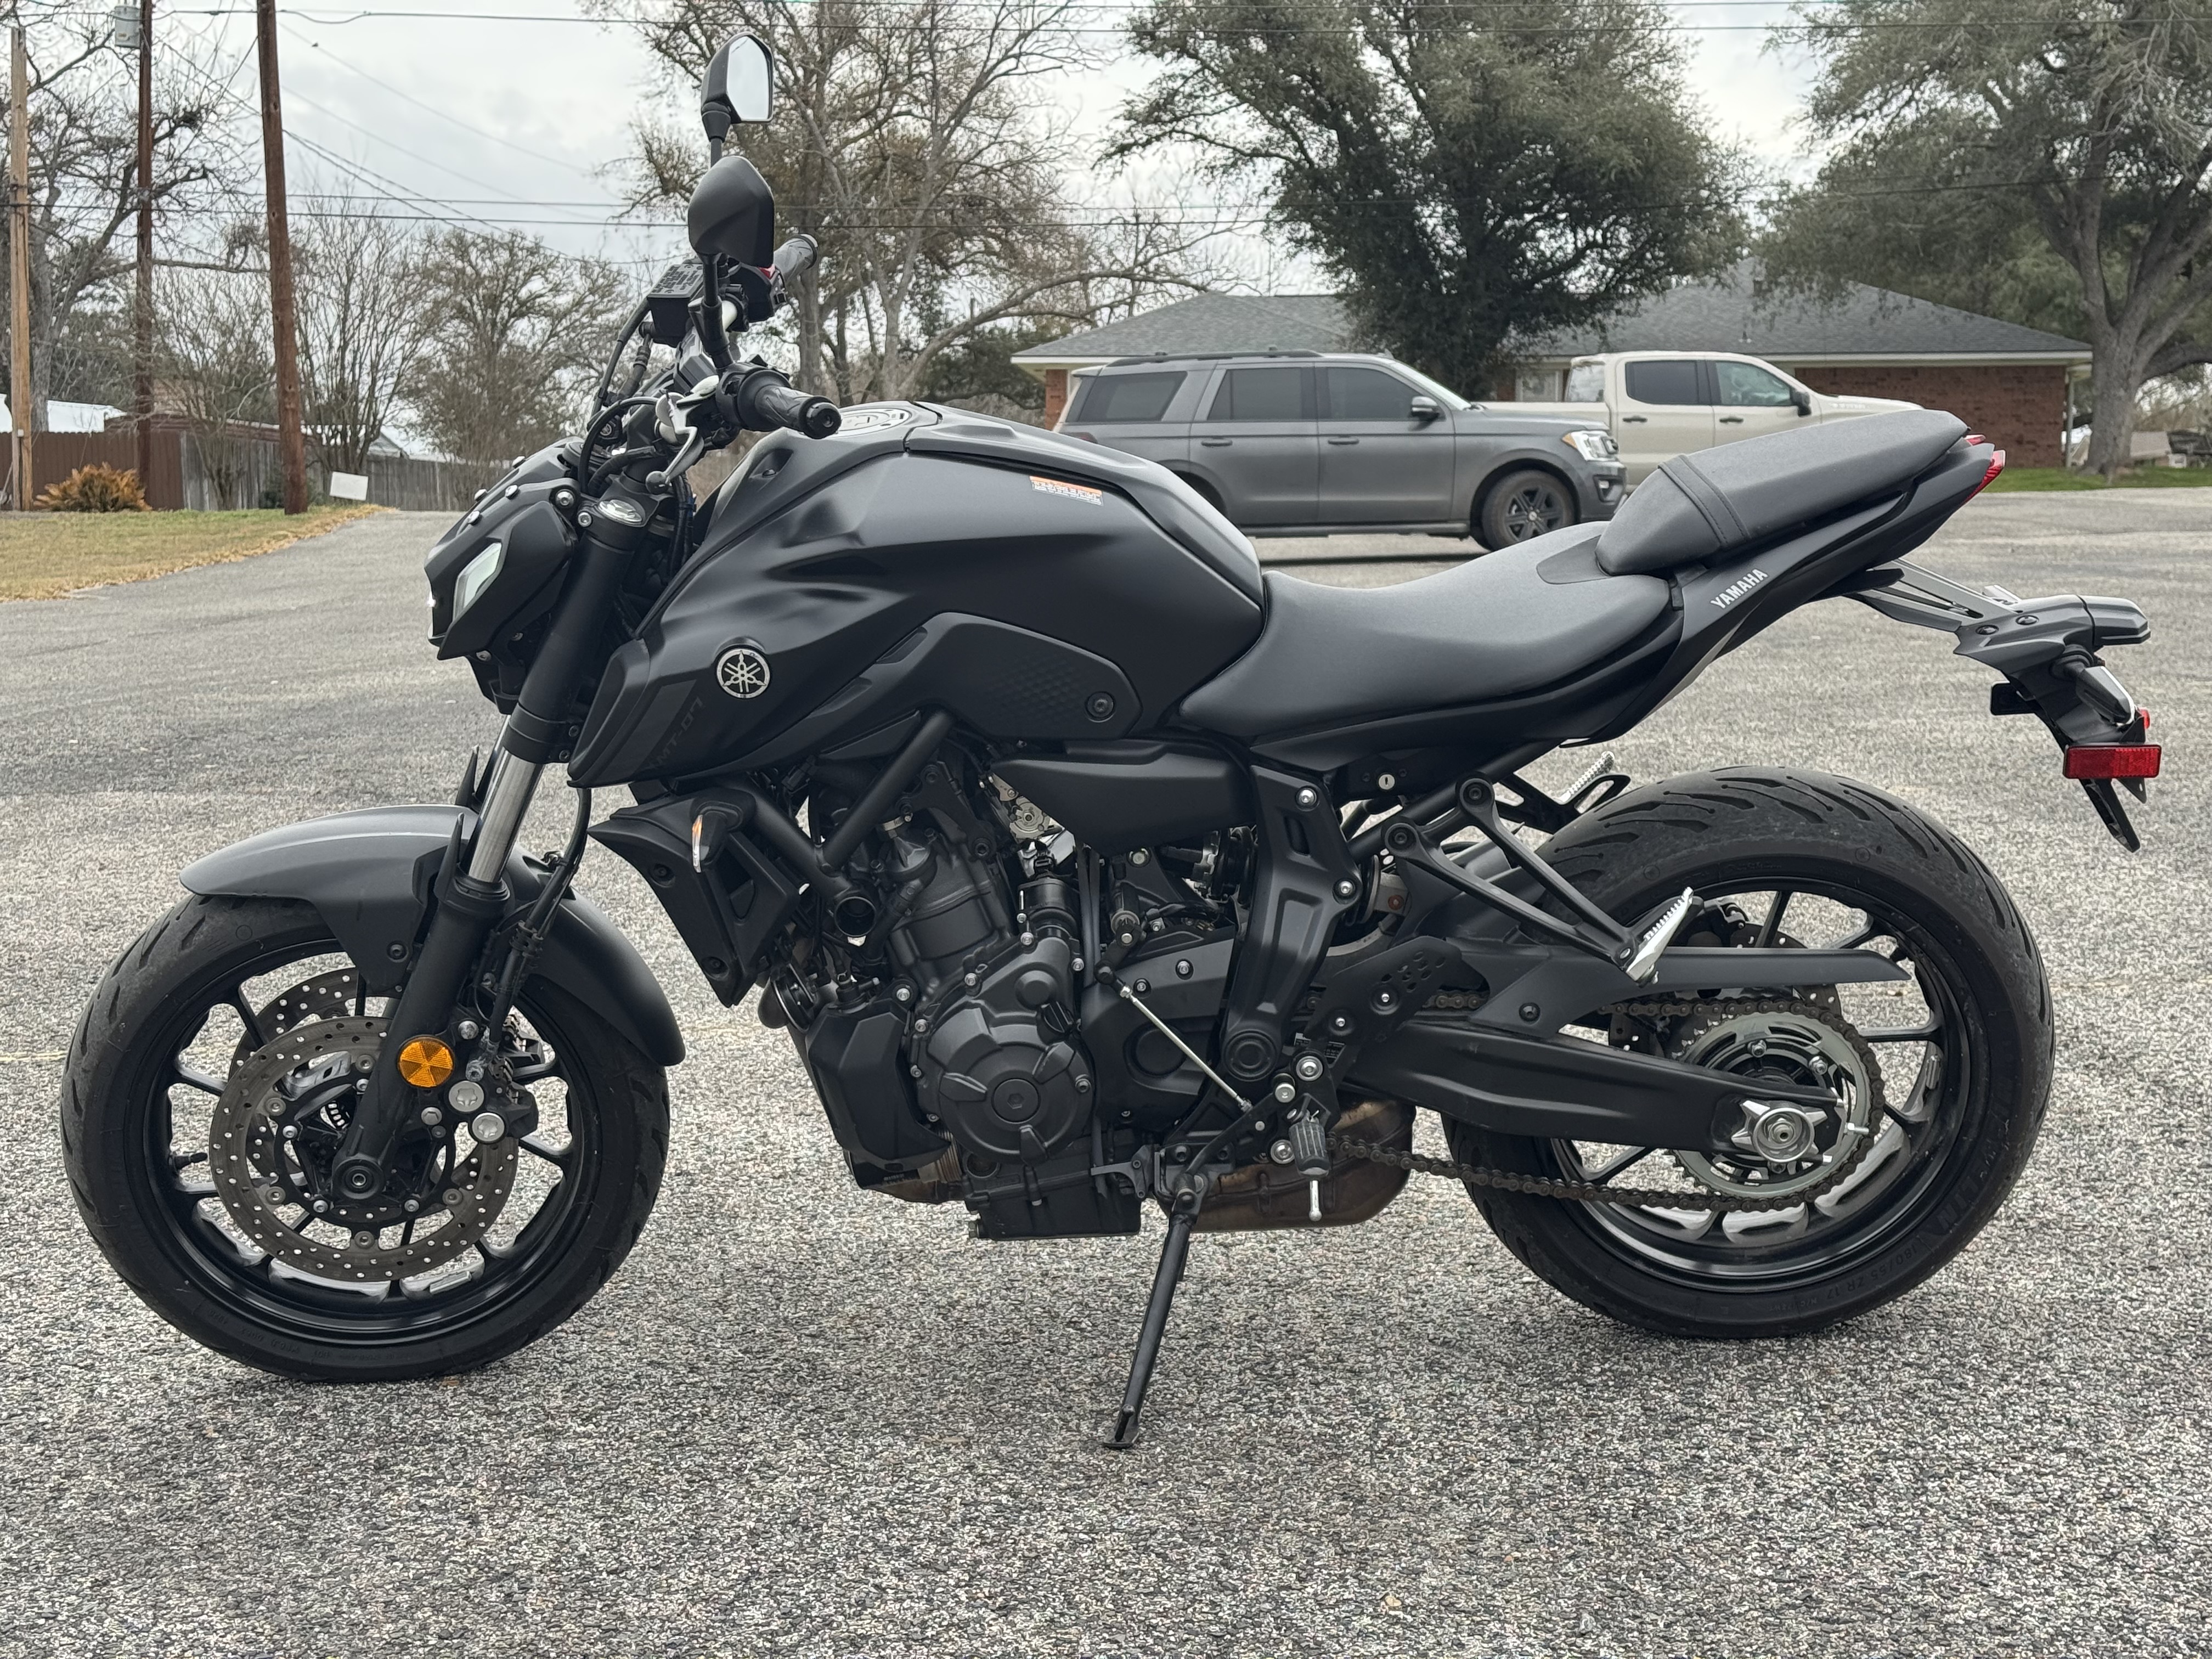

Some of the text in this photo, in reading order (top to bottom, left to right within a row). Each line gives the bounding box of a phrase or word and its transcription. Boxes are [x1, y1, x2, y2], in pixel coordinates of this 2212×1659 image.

[1711, 568, 1769, 610] YAMAHA
[1870, 1243, 1916, 1282] 180/55
[1827, 1287, 1841, 1300] 17
[1846, 1276, 1865, 1292] ZR
